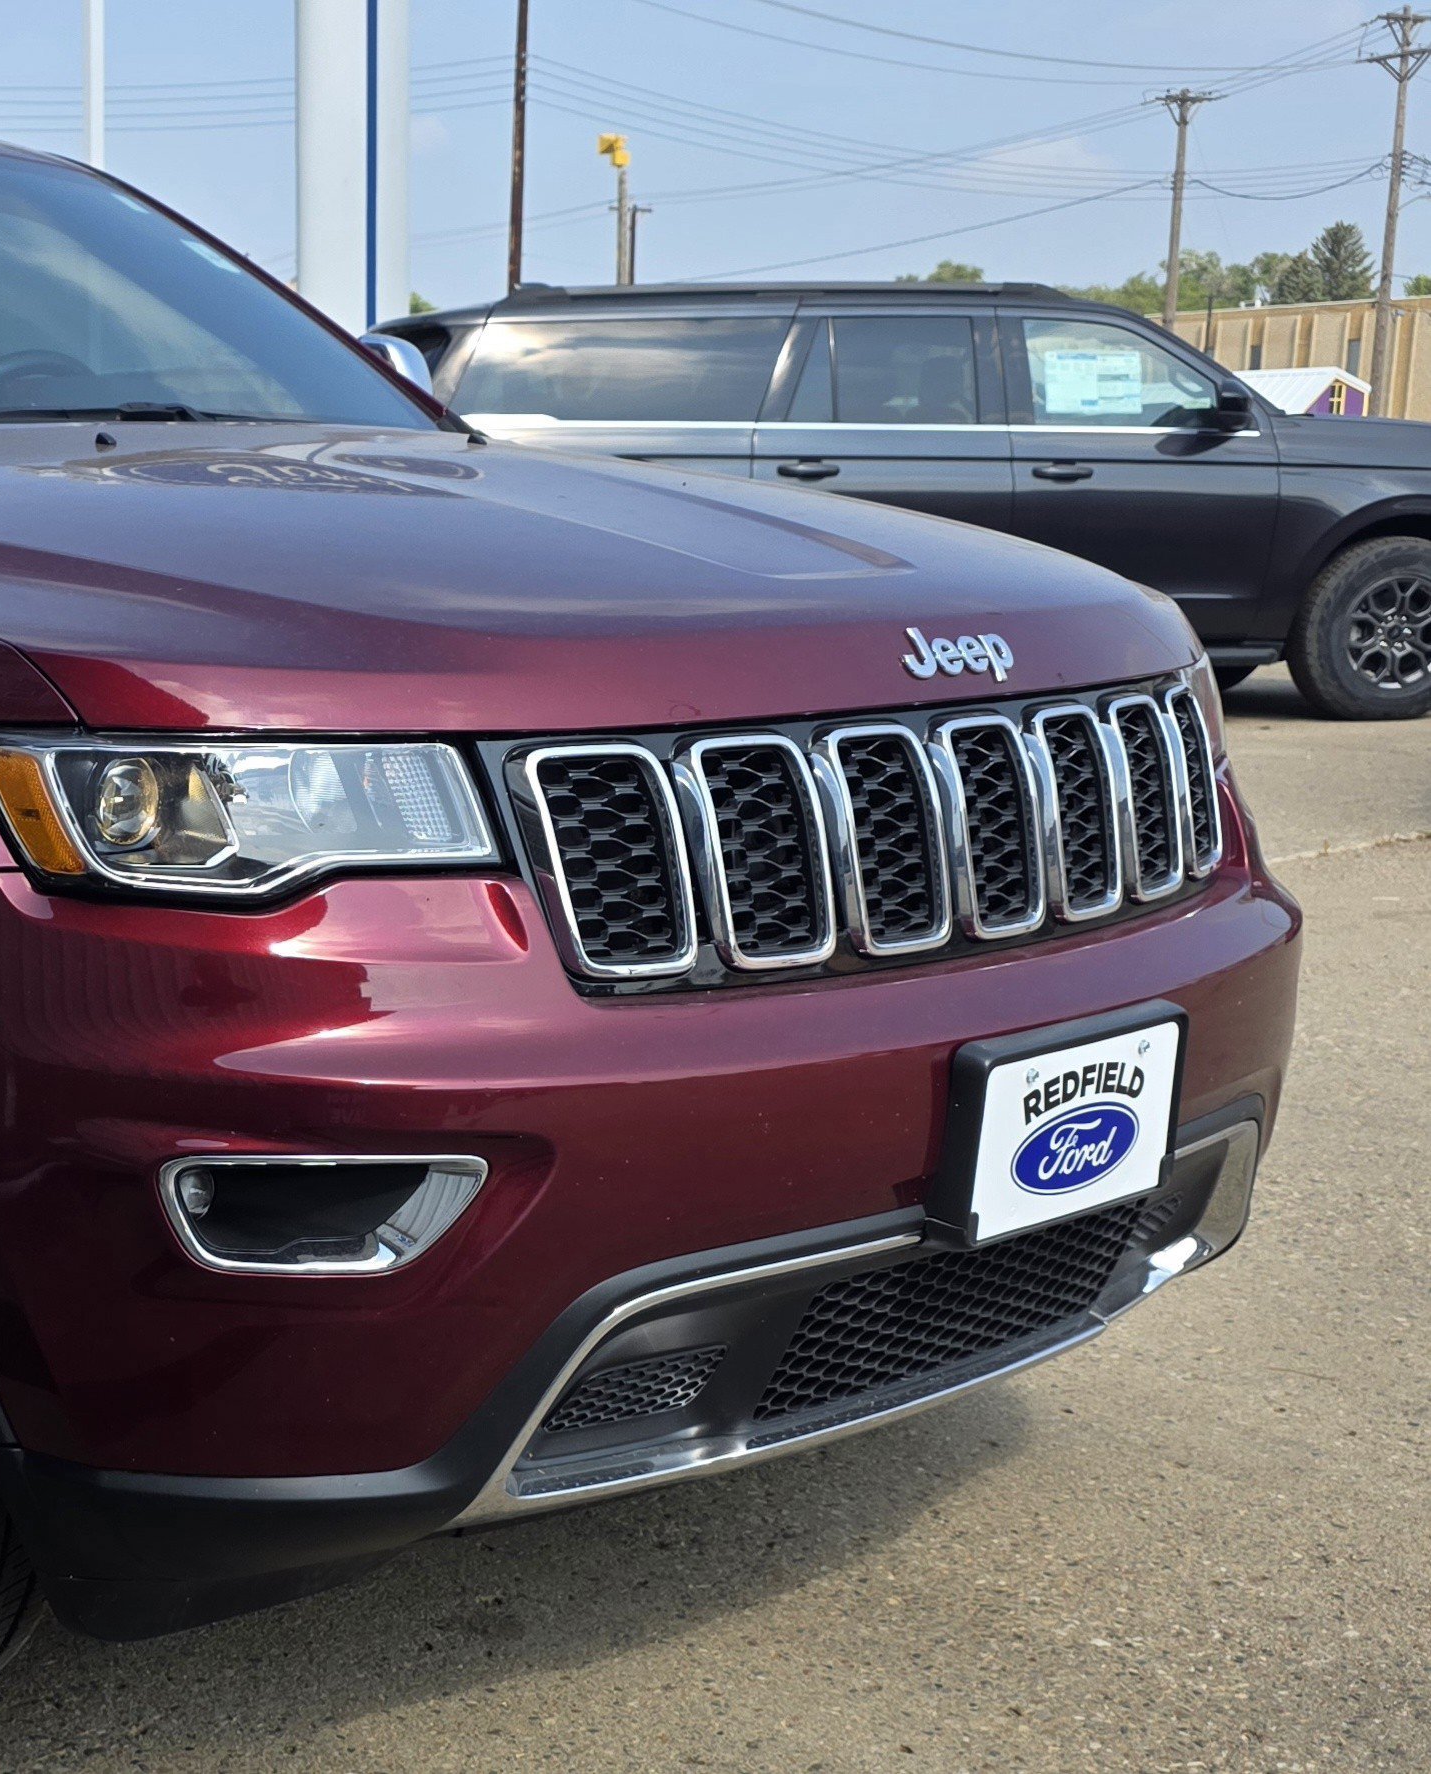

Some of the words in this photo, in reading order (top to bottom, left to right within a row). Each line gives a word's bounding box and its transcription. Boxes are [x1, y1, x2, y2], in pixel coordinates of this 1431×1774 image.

[900, 626, 1015, 682] Jeep
[1023, 1061, 1145, 1126] REDFIELD
[1037, 1117, 1118, 1182] Ford
